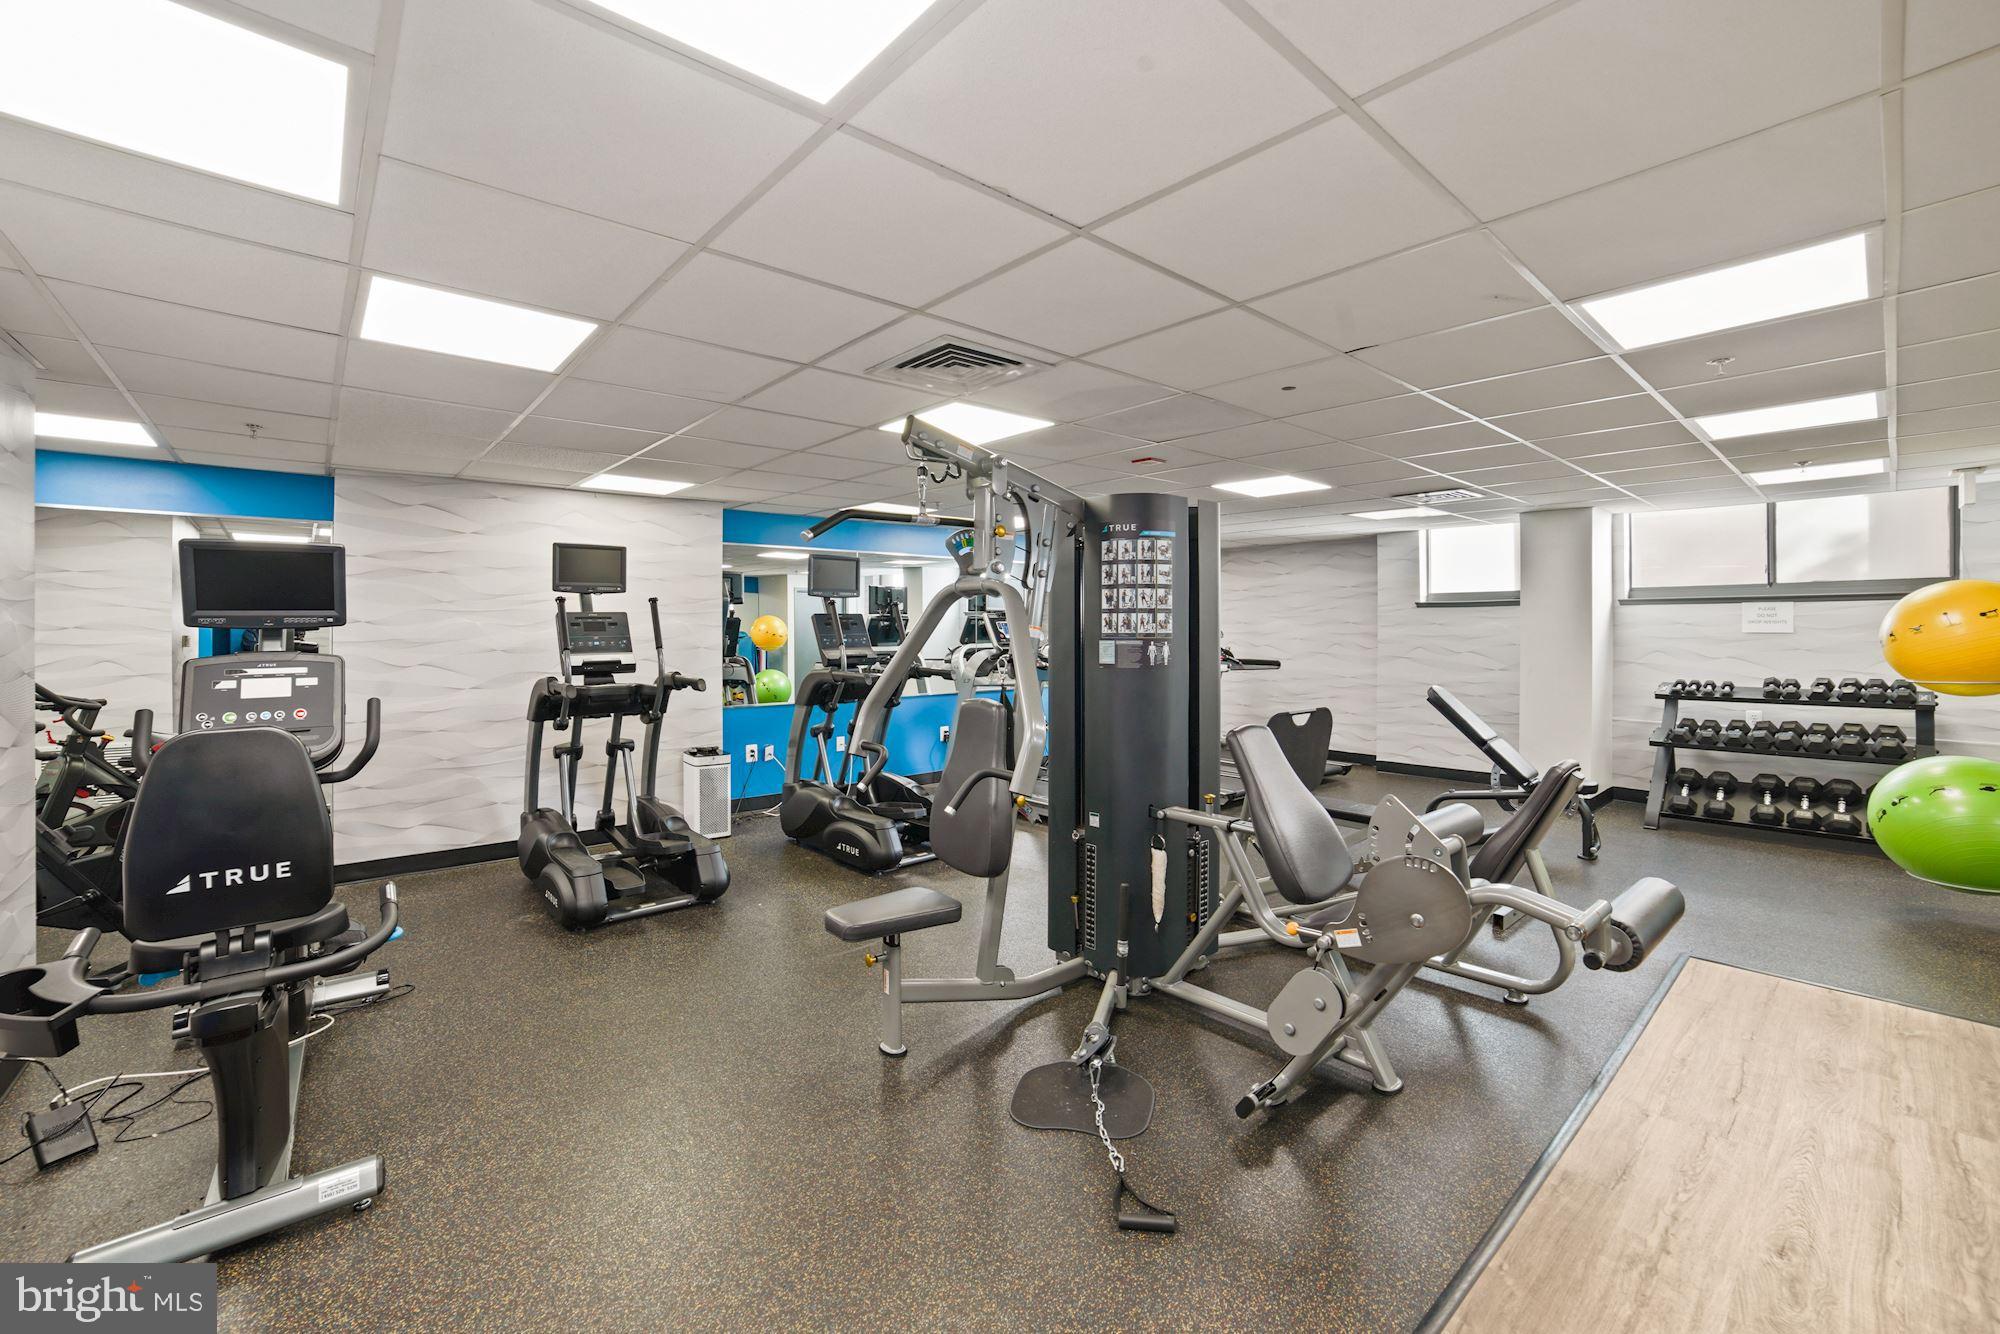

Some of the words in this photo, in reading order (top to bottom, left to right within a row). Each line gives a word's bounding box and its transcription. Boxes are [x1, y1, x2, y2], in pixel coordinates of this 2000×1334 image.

[1108, 524, 1137, 532] TRUE
[841, 843, 860, 857] TRUE
[199, 861, 291, 889] TRUE
